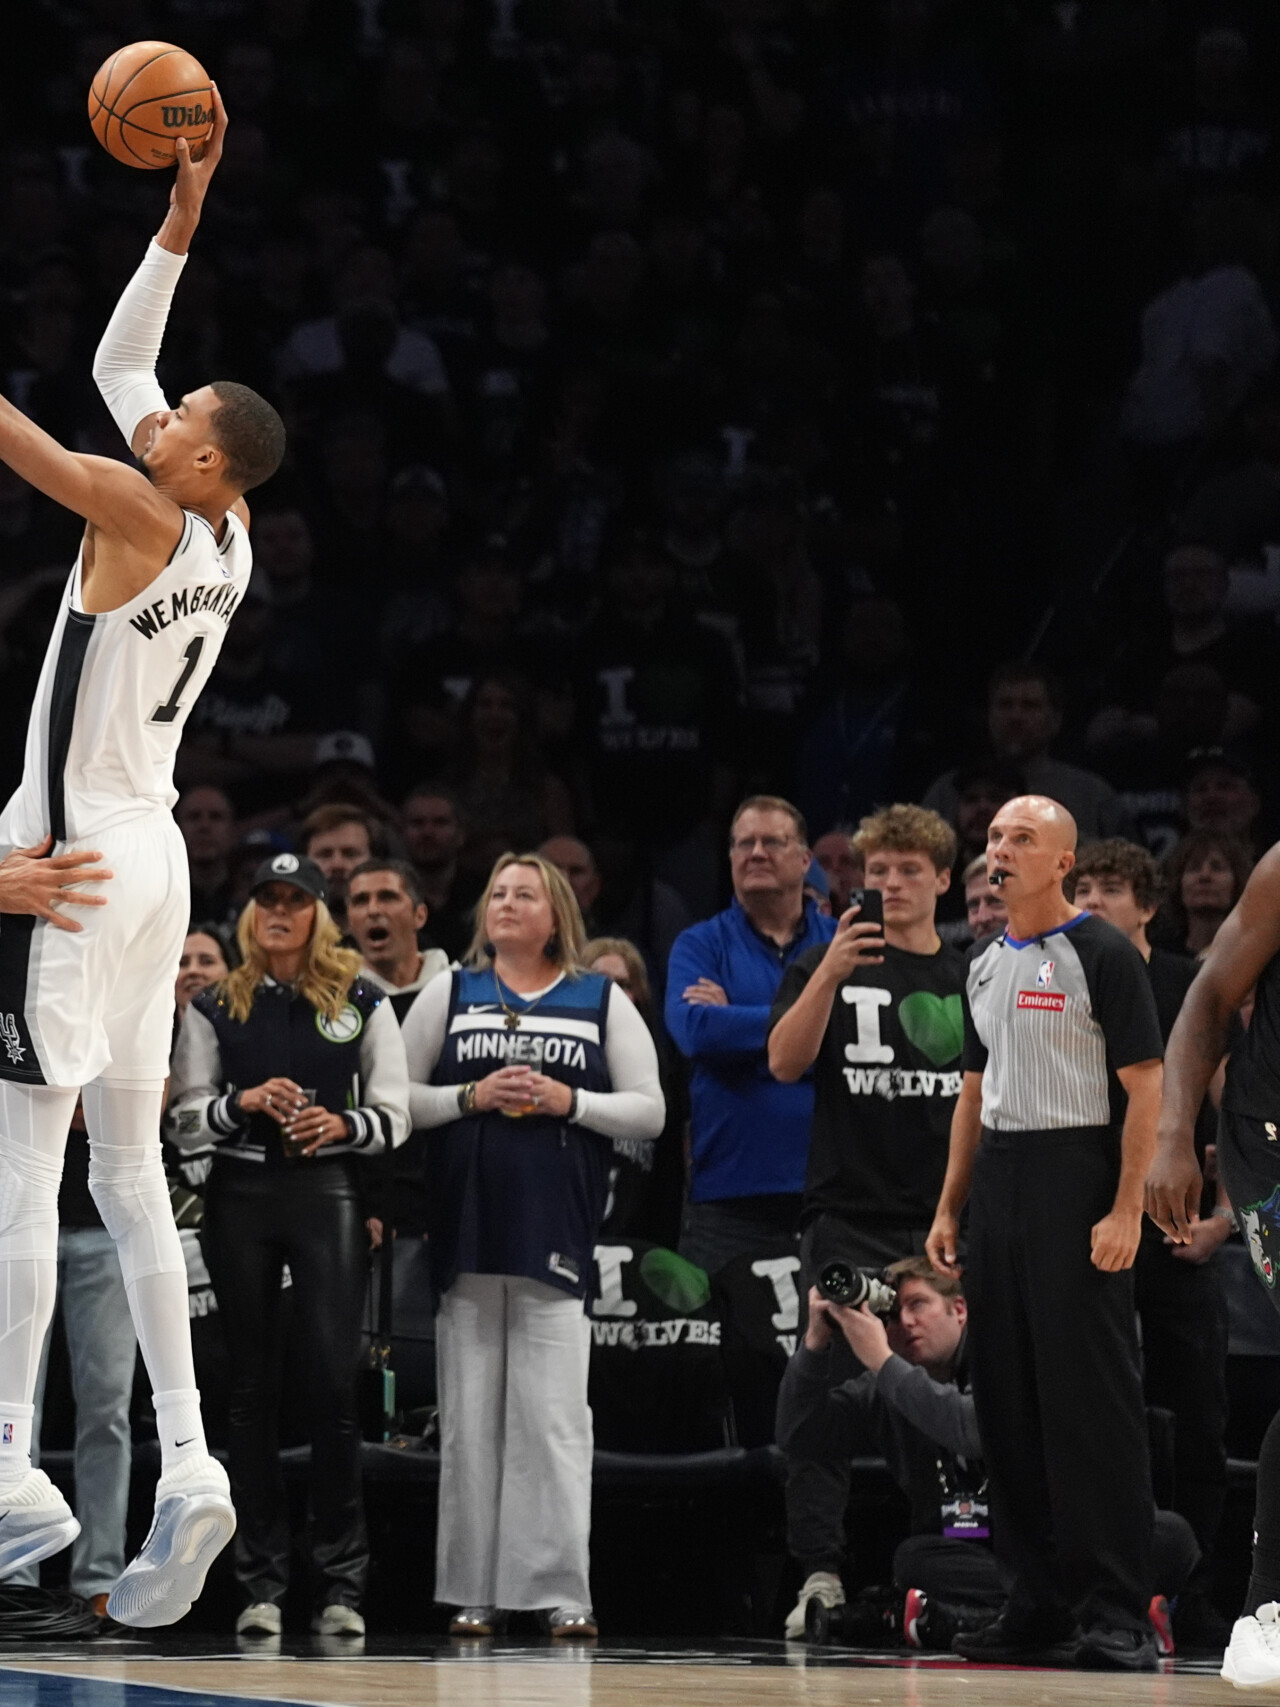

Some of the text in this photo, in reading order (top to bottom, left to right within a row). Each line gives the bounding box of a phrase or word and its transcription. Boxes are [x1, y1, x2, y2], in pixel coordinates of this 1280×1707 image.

[129, 583, 239, 640] WEMBANYA
[144, 631, 208, 727] 1
[841, 985, 895, 1064] I
[1018, 994, 1064, 1009] Emirates
[457, 1033, 587, 1071] MINNESOTA
[592, 1244, 638, 1317] I
